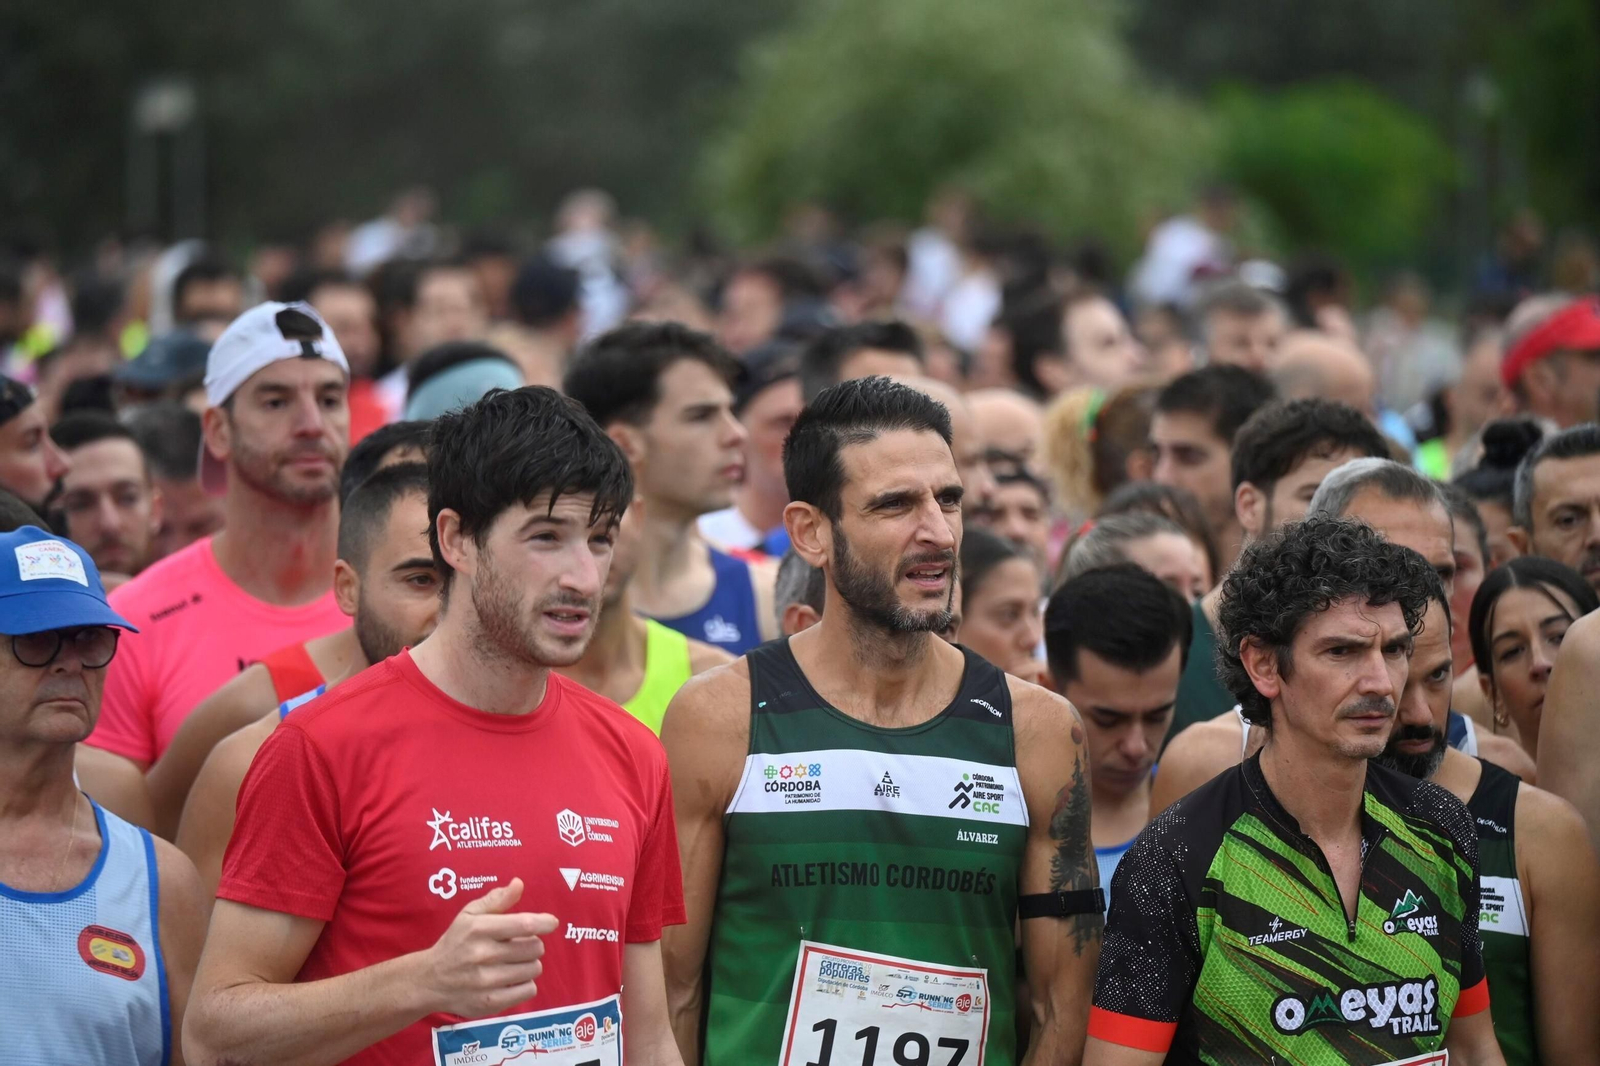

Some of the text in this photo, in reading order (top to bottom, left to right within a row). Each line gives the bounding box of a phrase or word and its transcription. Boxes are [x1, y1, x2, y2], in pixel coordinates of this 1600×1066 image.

[970, 699, 1002, 718] DECATHLON
[972, 773, 995, 782] CÓRDOBA
[764, 780, 821, 793] CÓRDOBA
[874, 784, 900, 795] AIRE
[975, 781, 1004, 791] PATRIMONIO
[972, 791, 1004, 801] AIRE SPORT
[973, 801, 999, 814] CAC
[449, 816, 514, 841] califas
[956, 829, 999, 845] ÁLVAREZ
[580, 872, 625, 887] AGRIMENSUR
[771, 862, 996, 895] ATLETISMO CORDOBÉS
[1480, 912, 1499, 924] AC
[1248, 928, 1308, 946] TEAMERGY
[821, 959, 863, 975] carreras
[819, 967, 870, 983] populares
[927, 999, 953, 1010] SERIES
[956, 996, 971, 1009] aje
[576, 1022, 594, 1039] aje
[1388, 1012, 1439, 1035] TRAIL
[541, 1036, 573, 1049] SERIES
[806, 1018, 970, 1066] 1197
[453, 1054, 488, 1065] IMDECO
